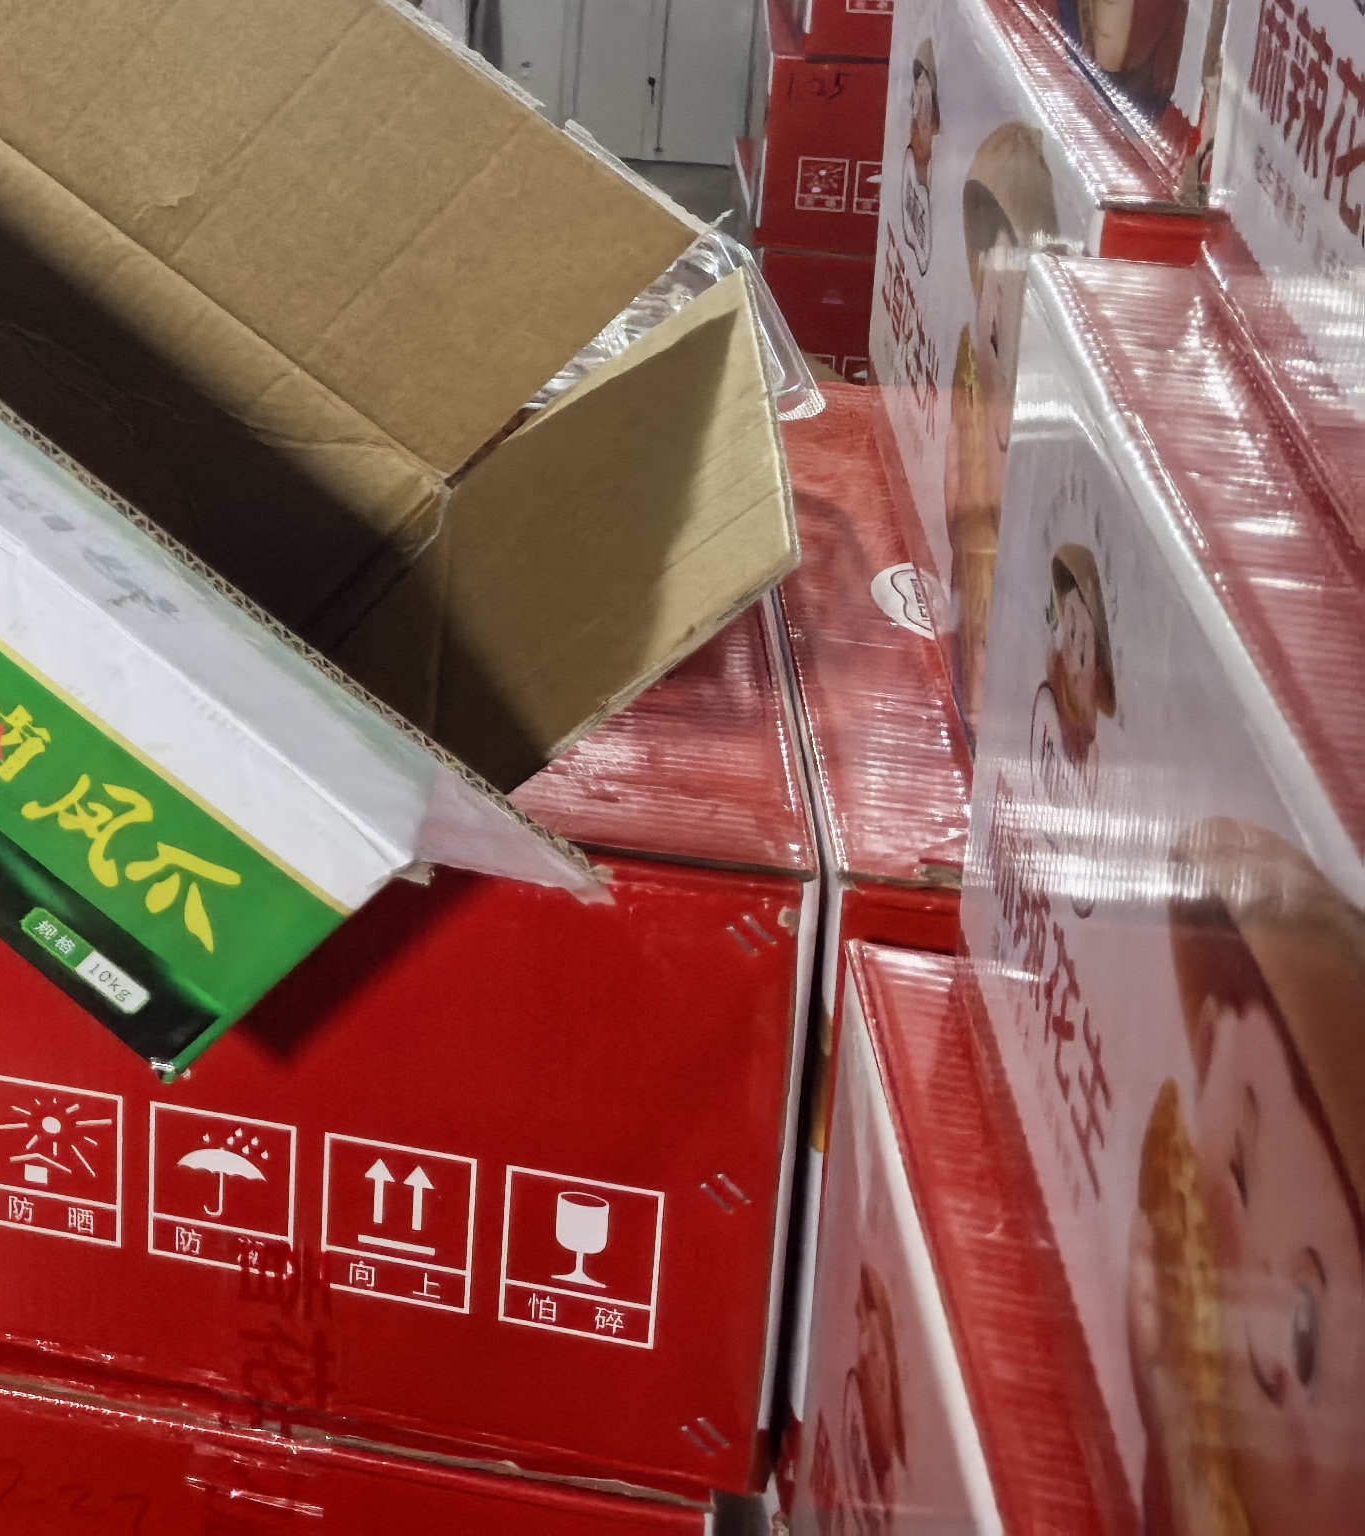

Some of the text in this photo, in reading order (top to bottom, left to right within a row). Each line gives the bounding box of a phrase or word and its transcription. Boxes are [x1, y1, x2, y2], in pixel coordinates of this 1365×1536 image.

[30, 916, 78, 957] 规格
[85, 959, 134, 1006] 10kg
[8, 1195, 95, 1236] 防晒
[349, 1260, 441, 1300] 向上
[527, 1292, 625, 1336] 怕碎
